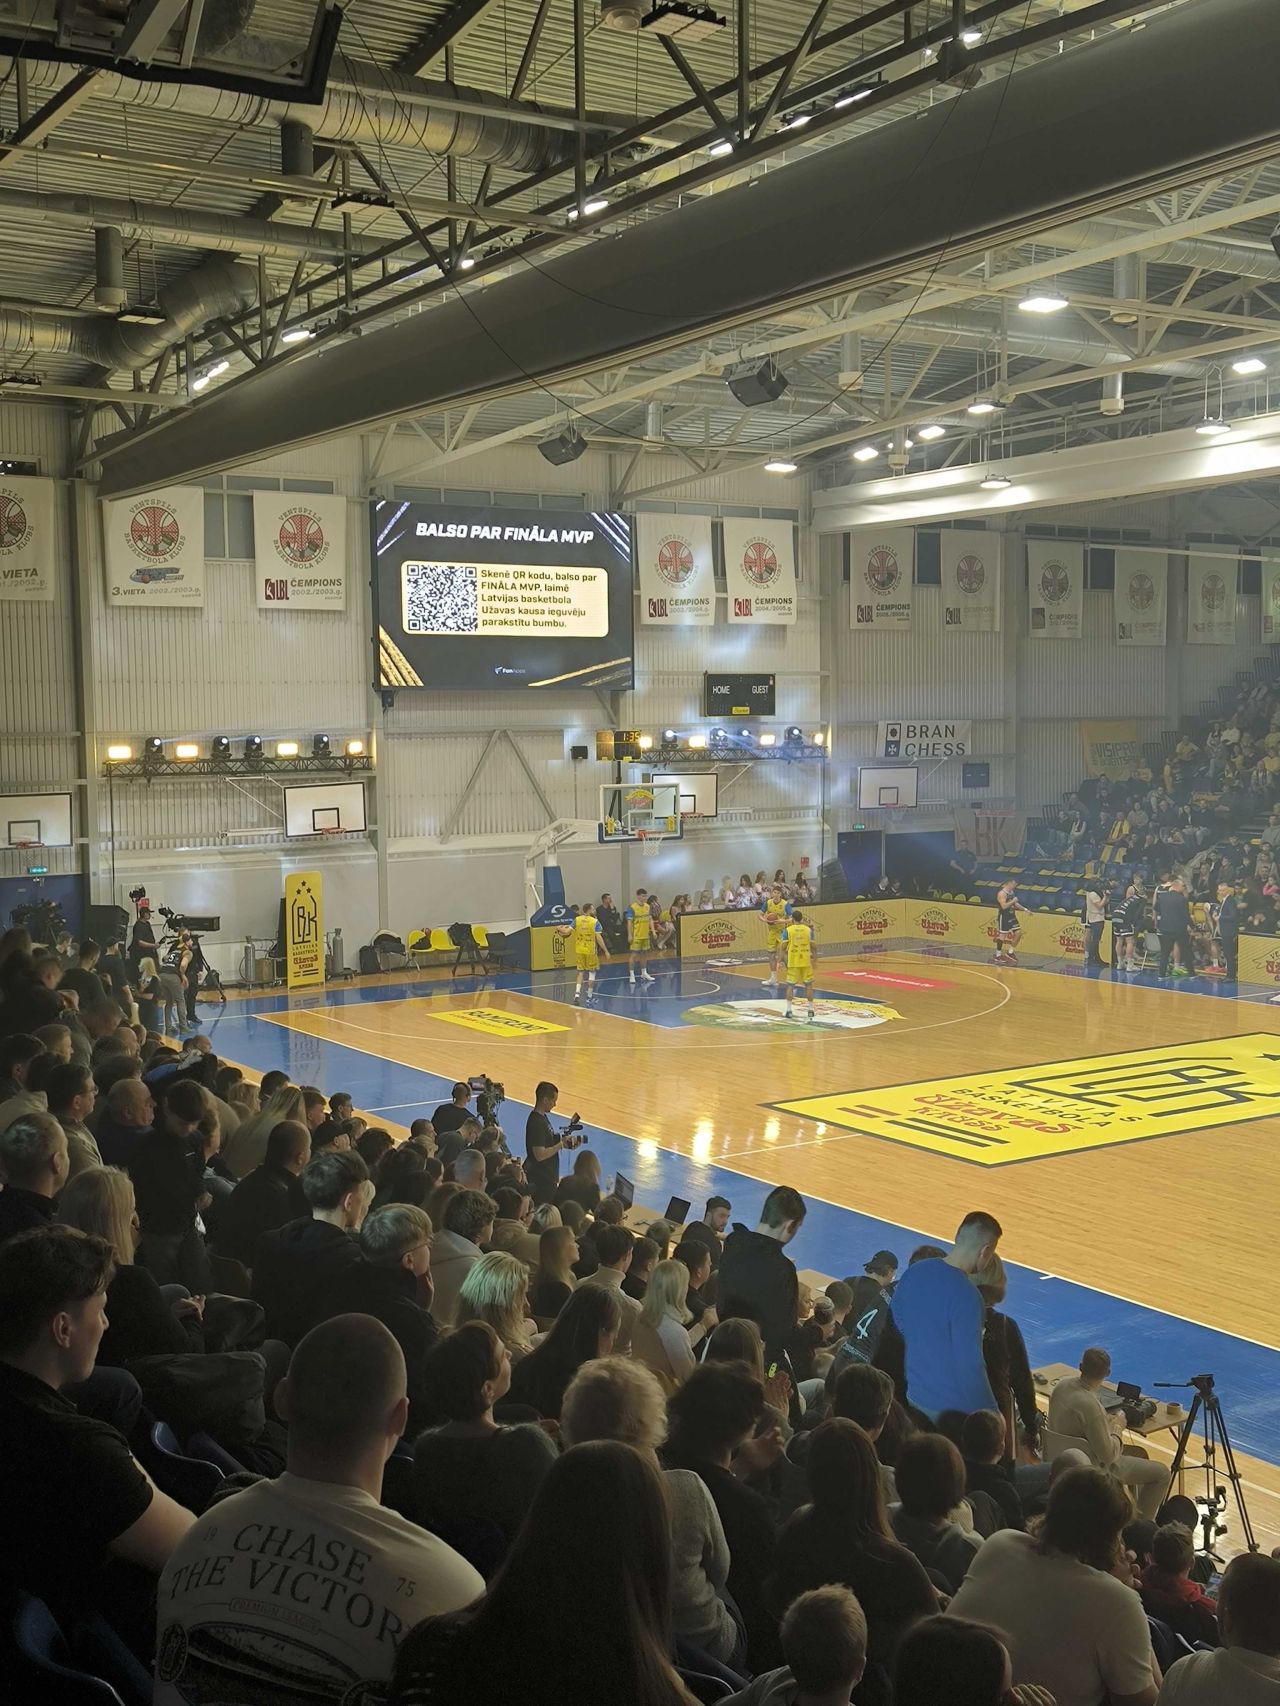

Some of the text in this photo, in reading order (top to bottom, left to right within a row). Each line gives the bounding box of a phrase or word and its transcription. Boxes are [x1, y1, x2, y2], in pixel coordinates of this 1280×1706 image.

[129, 499, 177, 515] VENTSPILS
[416, 523, 594, 544] BALSO PAR FINĀLA MVP
[290, 578, 343, 587] ČEMPIONS
[513, 571, 526, 580] QR
[528, 571, 553, 580] kodu,
[555, 572, 580, 581] balso
[582, 574, 597, 583] par
[481, 580, 517, 590] FINĀLA
[481, 594, 572, 604] Latvijas basketbola
[669, 597, 710, 606] ČEMPIONS
[755, 596, 793, 605] ČEMPIONS
[481, 605, 515, 615] Užavas
[518, 607, 545, 615] kausa
[532, 619, 567, 628] bumbu.
[713, 685, 768, 694] HOME GUEST
[906, 725, 955, 738] BRAN
[905, 743, 965, 756] CHESS
[952, 1088, 1112, 1128] BASKETBOLA
[978, 1084, 1143, 1123] LATVIJAS
[856, 1308, 879, 1340] 4
[233, 1523, 373, 1585] CHASE
[394, 1575, 417, 1598] 75
[170, 1555, 408, 1648] THE VICTOR
